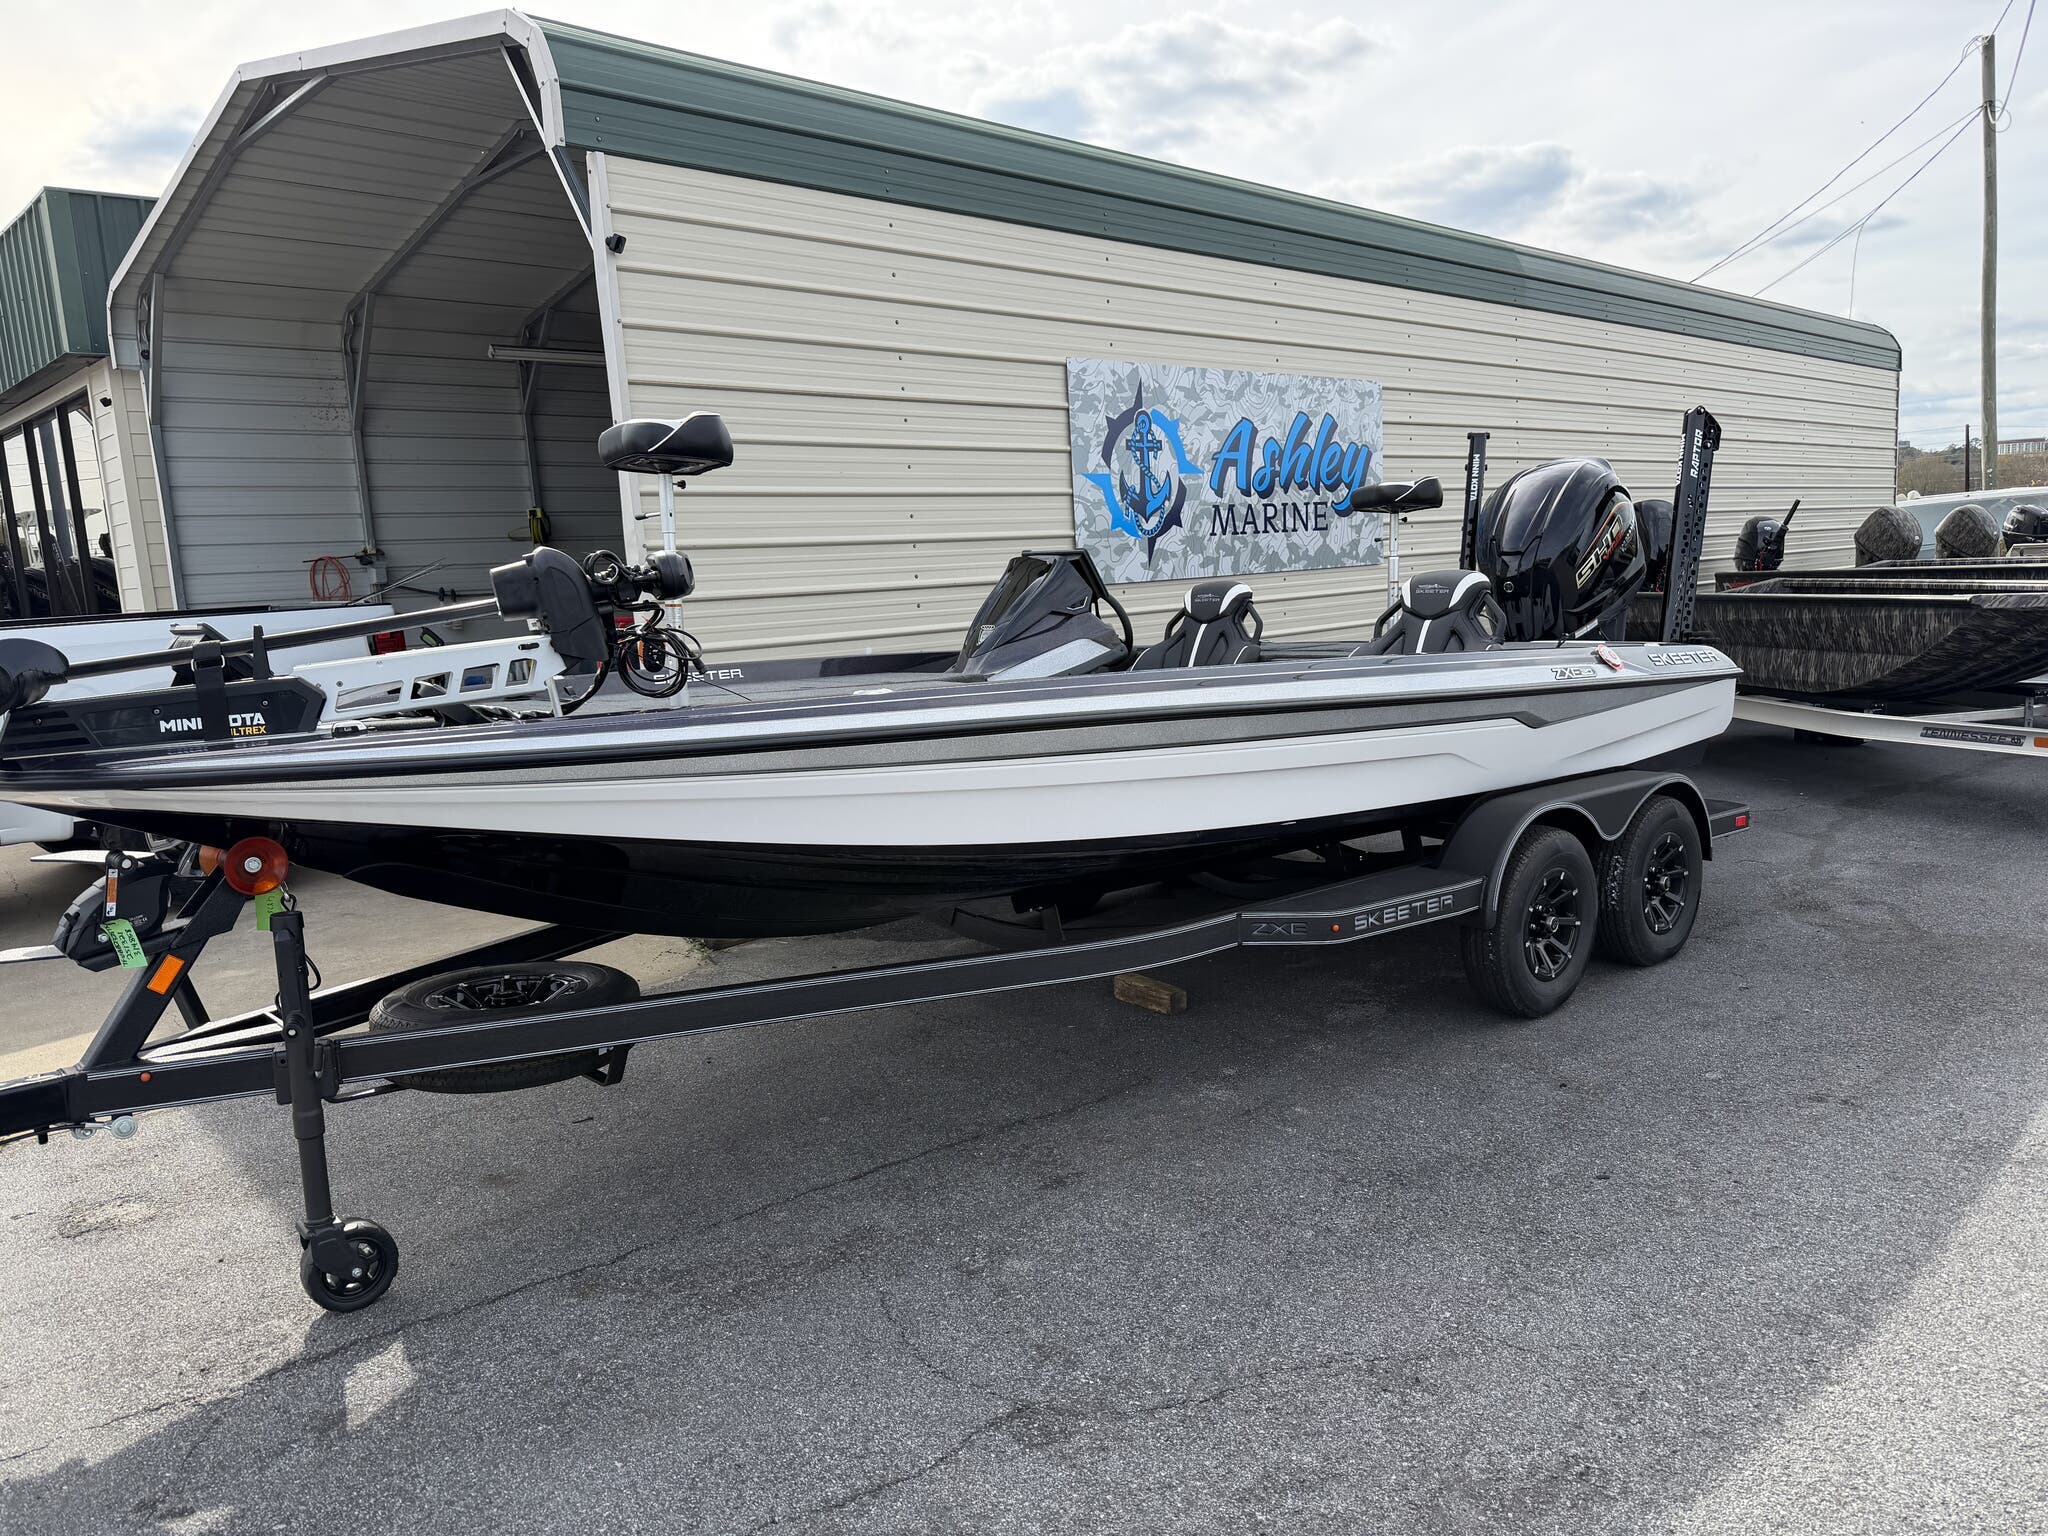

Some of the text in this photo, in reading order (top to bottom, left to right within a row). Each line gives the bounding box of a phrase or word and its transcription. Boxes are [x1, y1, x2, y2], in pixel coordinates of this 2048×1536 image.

[1209, 411, 1373, 517] Ashley
[1690, 428, 1704, 478] RAPTOR
[1470, 454, 1481, 501] MINN KOTA
[1209, 501, 1329, 536] MARINE
[1648, 651, 1720, 666] SKEETER
[230, 725, 267, 736] LTREX
[1922, 728, 2008, 745] TENNESSEE
[1251, 922, 1309, 936] ZXE
[1354, 895, 1454, 931] SKEETER
